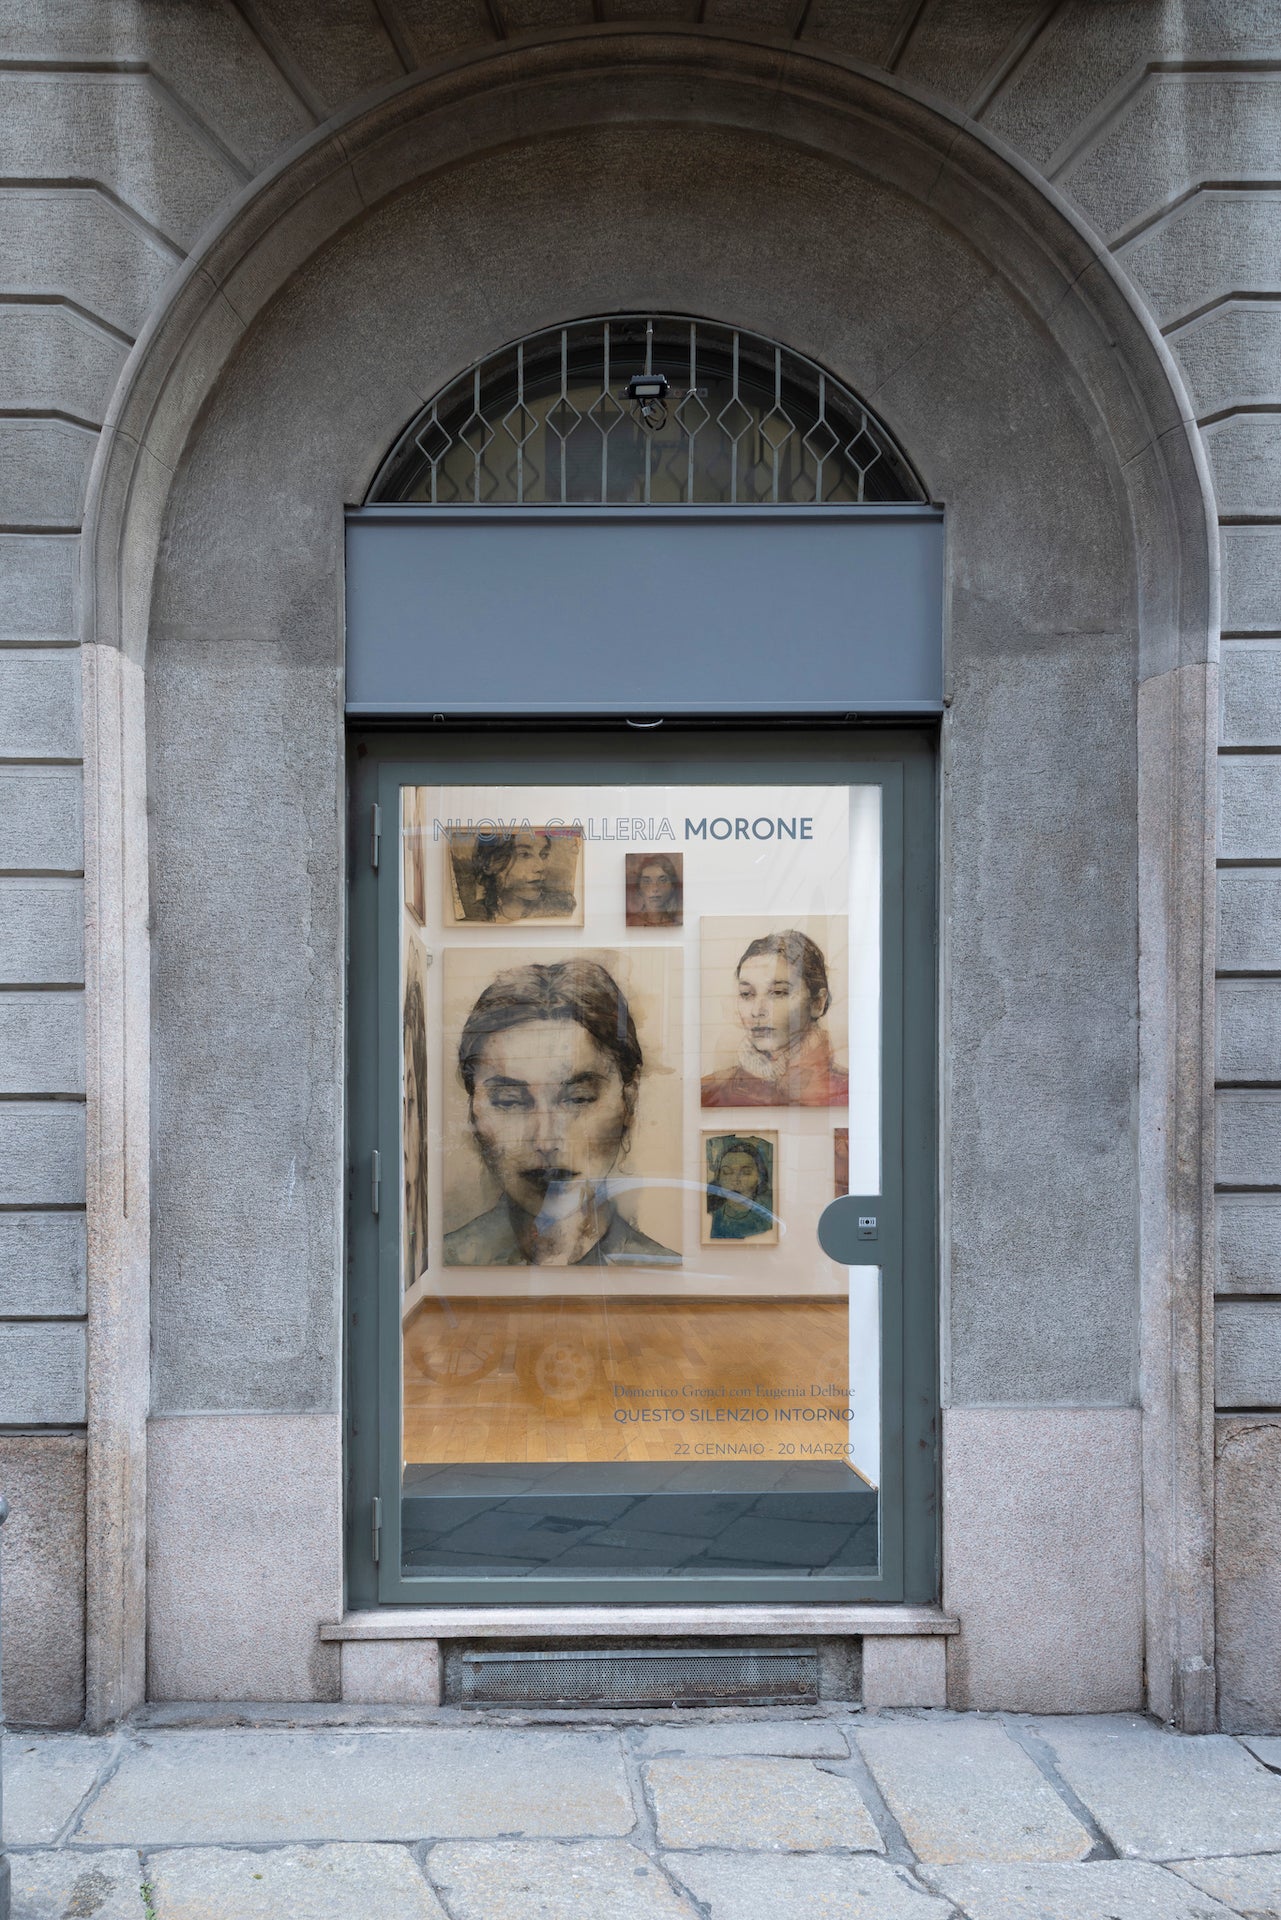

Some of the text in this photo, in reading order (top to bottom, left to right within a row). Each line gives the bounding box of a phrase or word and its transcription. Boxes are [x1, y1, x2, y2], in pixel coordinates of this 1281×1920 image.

[433, 817, 813, 841] NUOVA GALLERIA MORONE
[613, 1384, 856, 1400] Domenico Grenci con Eugenia Delbue
[613, 1408, 855, 1424] QUESTO SILENZIO INTORNO
[674, 1443, 690, 1455] 22
[694, 1443, 765, 1455] GENNAIO
[778, 1443, 795, 1455] 20
[800, 1443, 855, 1455] MARZO
